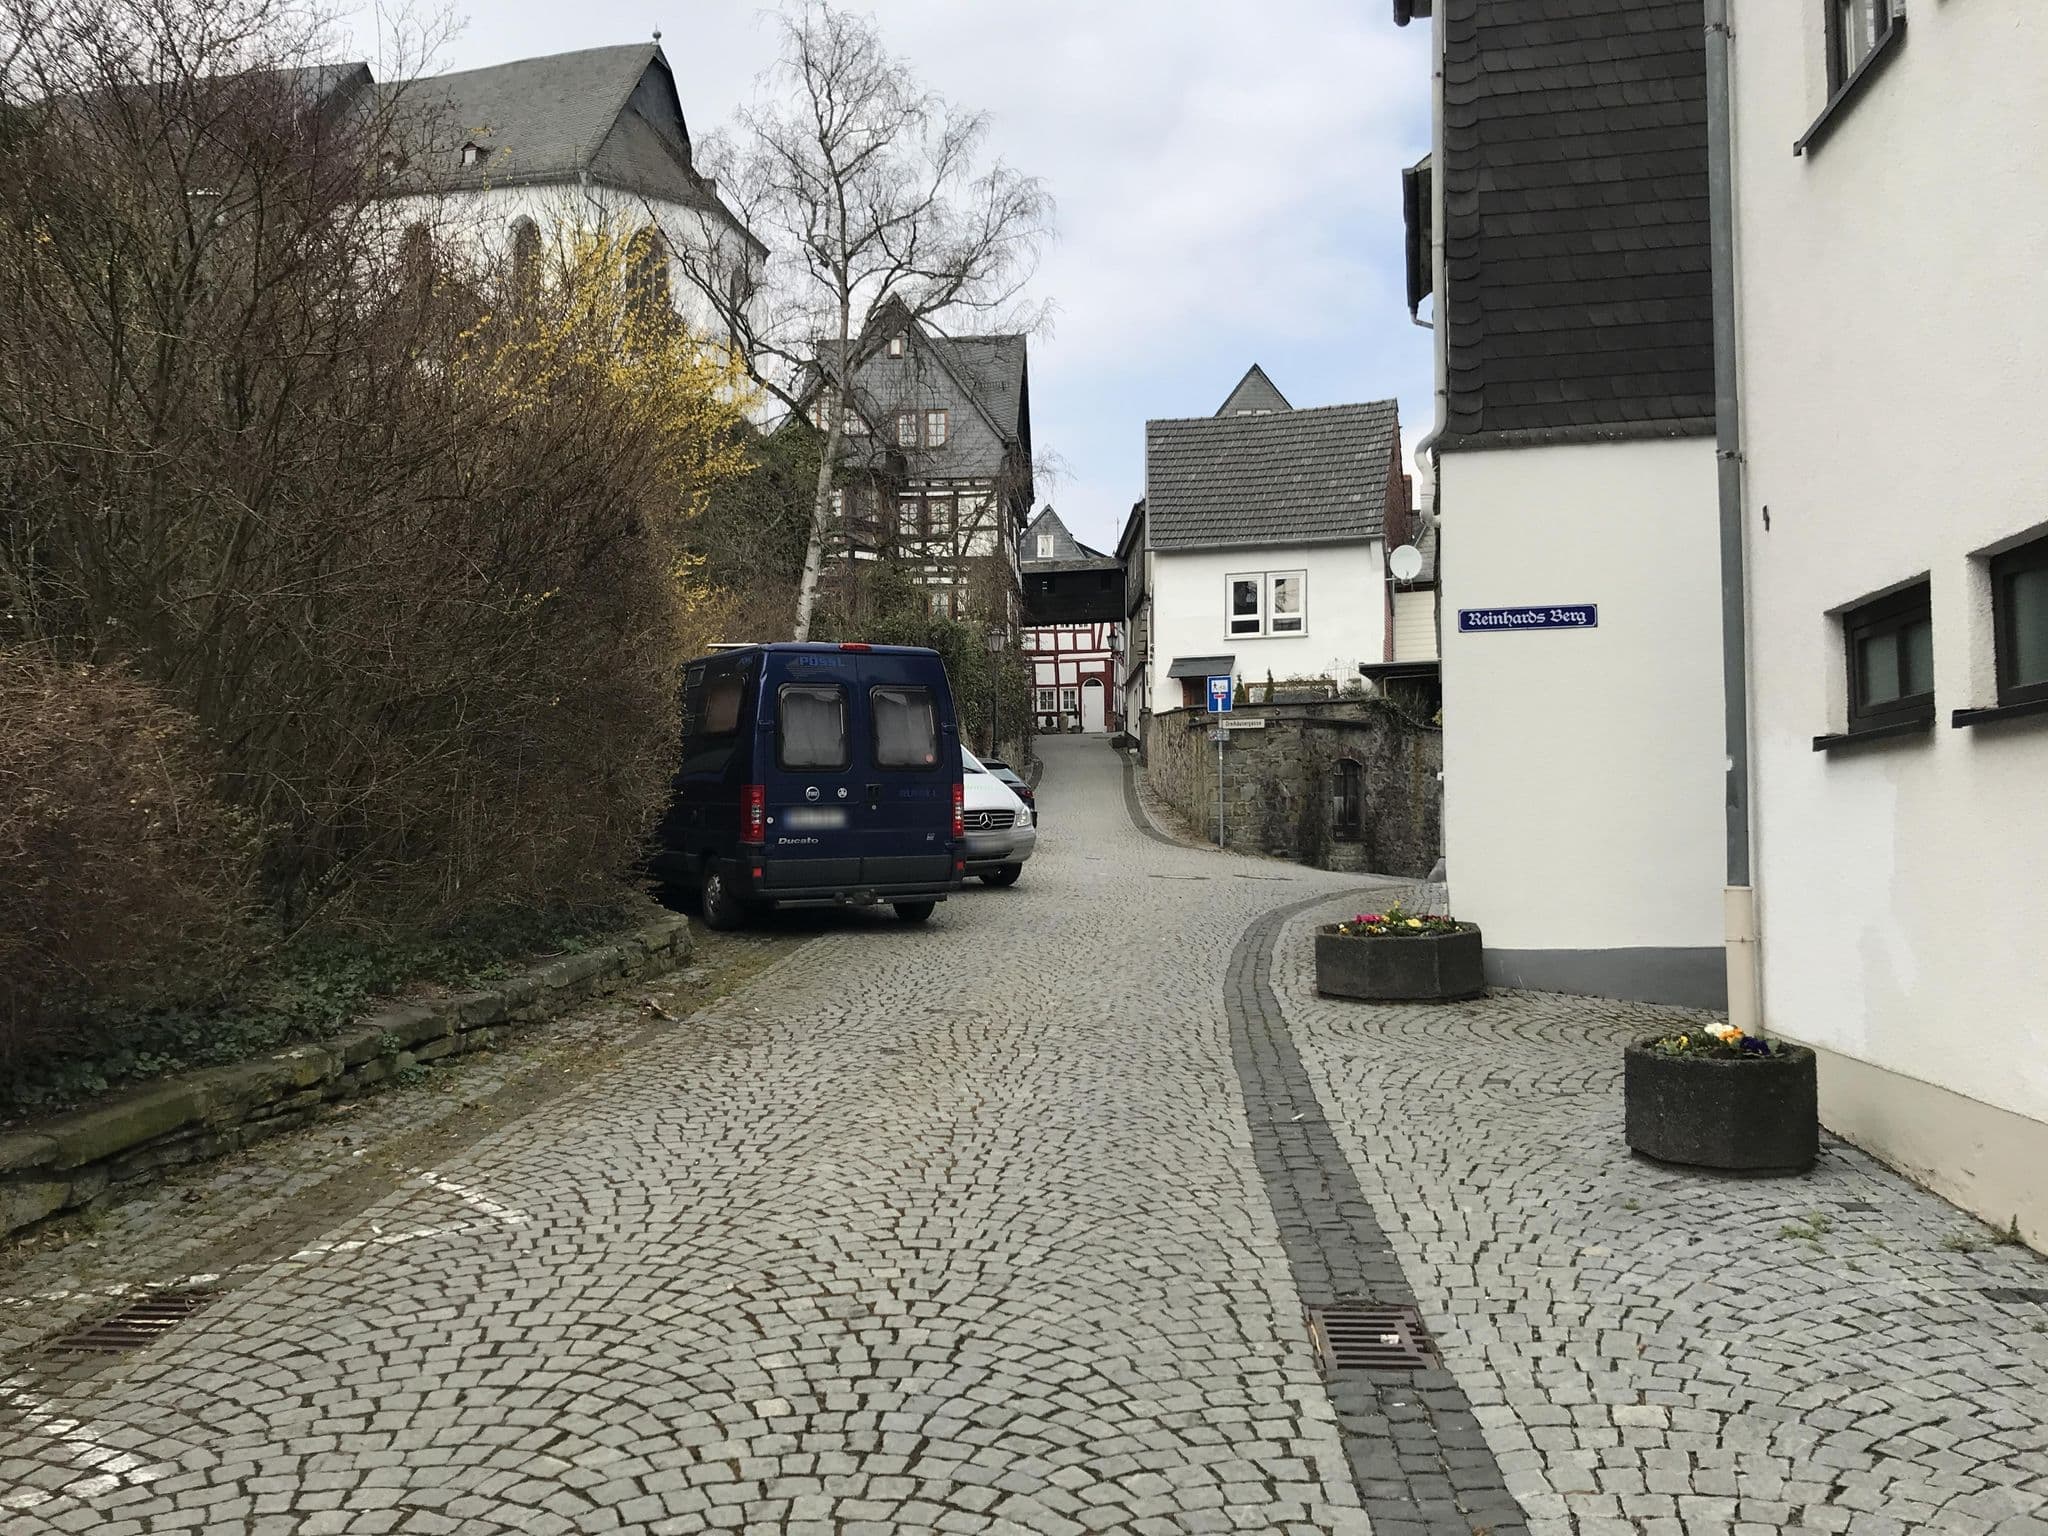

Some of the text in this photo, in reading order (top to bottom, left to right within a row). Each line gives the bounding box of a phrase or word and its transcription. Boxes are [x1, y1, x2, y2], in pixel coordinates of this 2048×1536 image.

[1468, 608, 1587, 627] Reinhards Berg
[777, 836, 819, 845] Ducato
